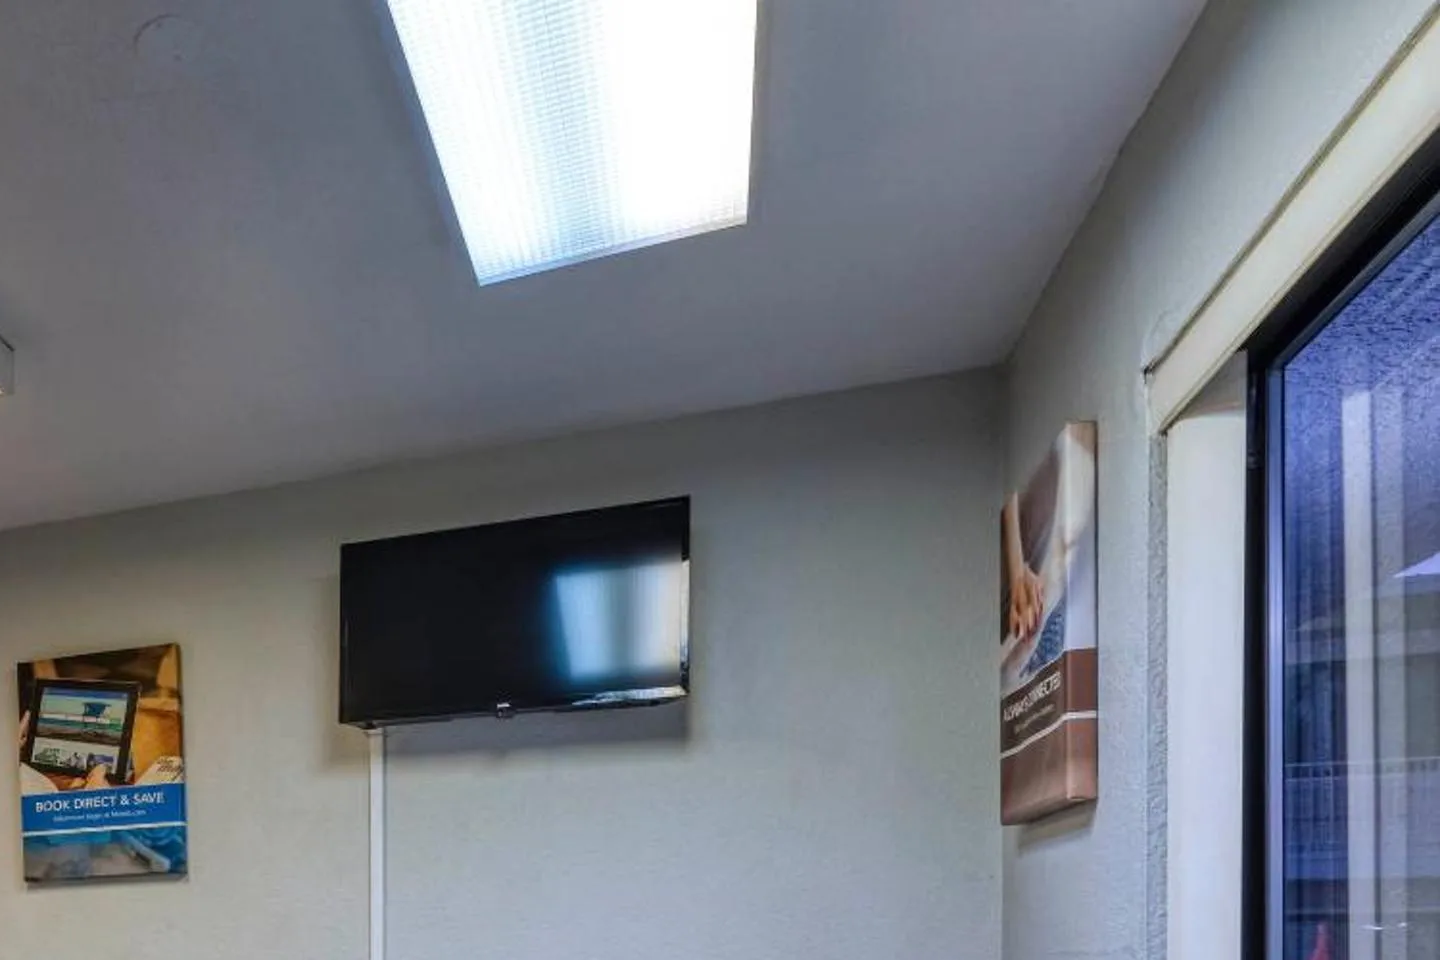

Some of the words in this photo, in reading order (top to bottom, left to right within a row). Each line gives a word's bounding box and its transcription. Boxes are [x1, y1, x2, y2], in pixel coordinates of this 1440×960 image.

[35, 799, 71, 813] BOOK
[73, 795, 117, 810] DIRECT
[120, 794, 131, 806] &
[133, 791, 165, 804] SAVE
